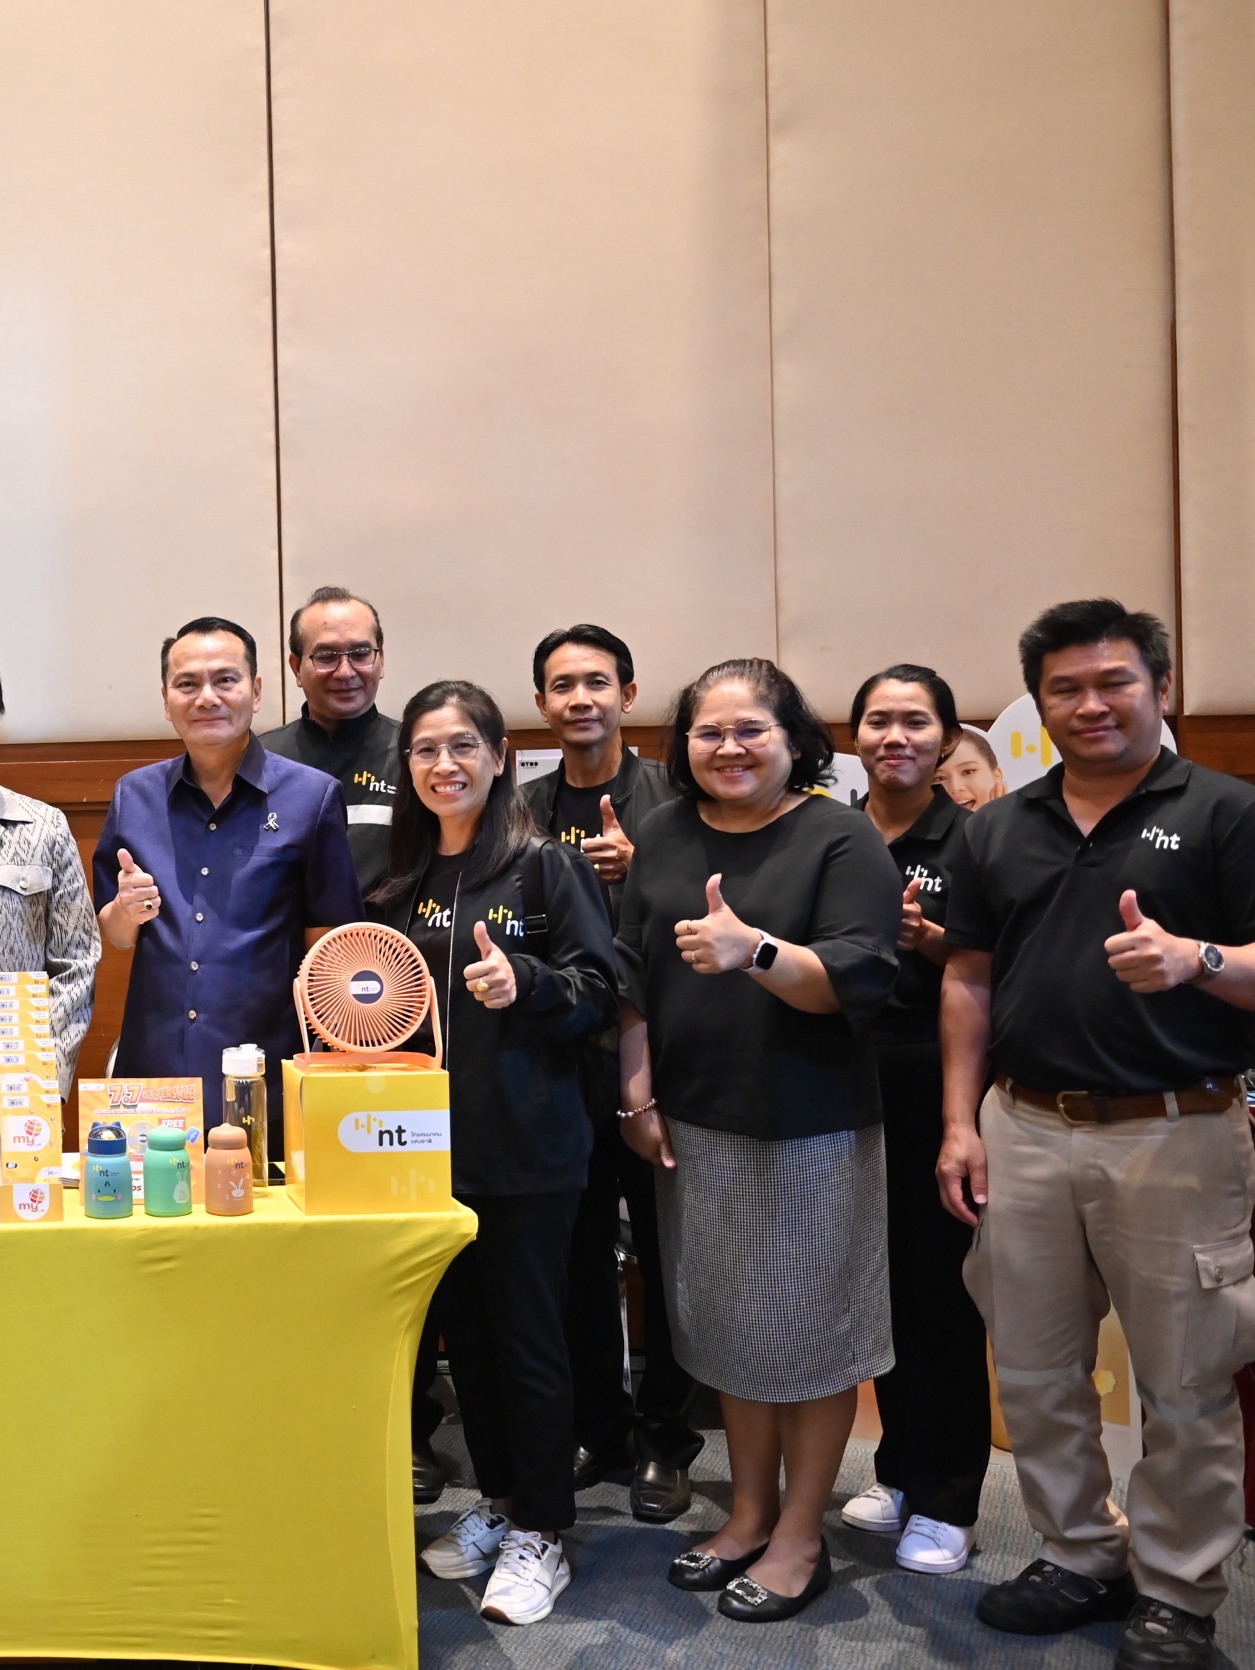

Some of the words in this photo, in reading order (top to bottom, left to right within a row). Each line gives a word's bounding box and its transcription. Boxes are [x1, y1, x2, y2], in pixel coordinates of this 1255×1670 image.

[369, 780, 386, 792] nt
[1155, 833, 1181, 850] nt
[919, 876, 943, 892] nt
[427, 908, 451, 928] nt
[505, 919, 524, 937] nt
[12, 1135, 35, 1147] my
[378, 1125, 407, 1147] nt
[177, 1161, 185, 1169] nt
[235, 1161, 244, 1169] nt
[99, 1169, 109, 1177] nt
[18, 1203, 38, 1213] my
